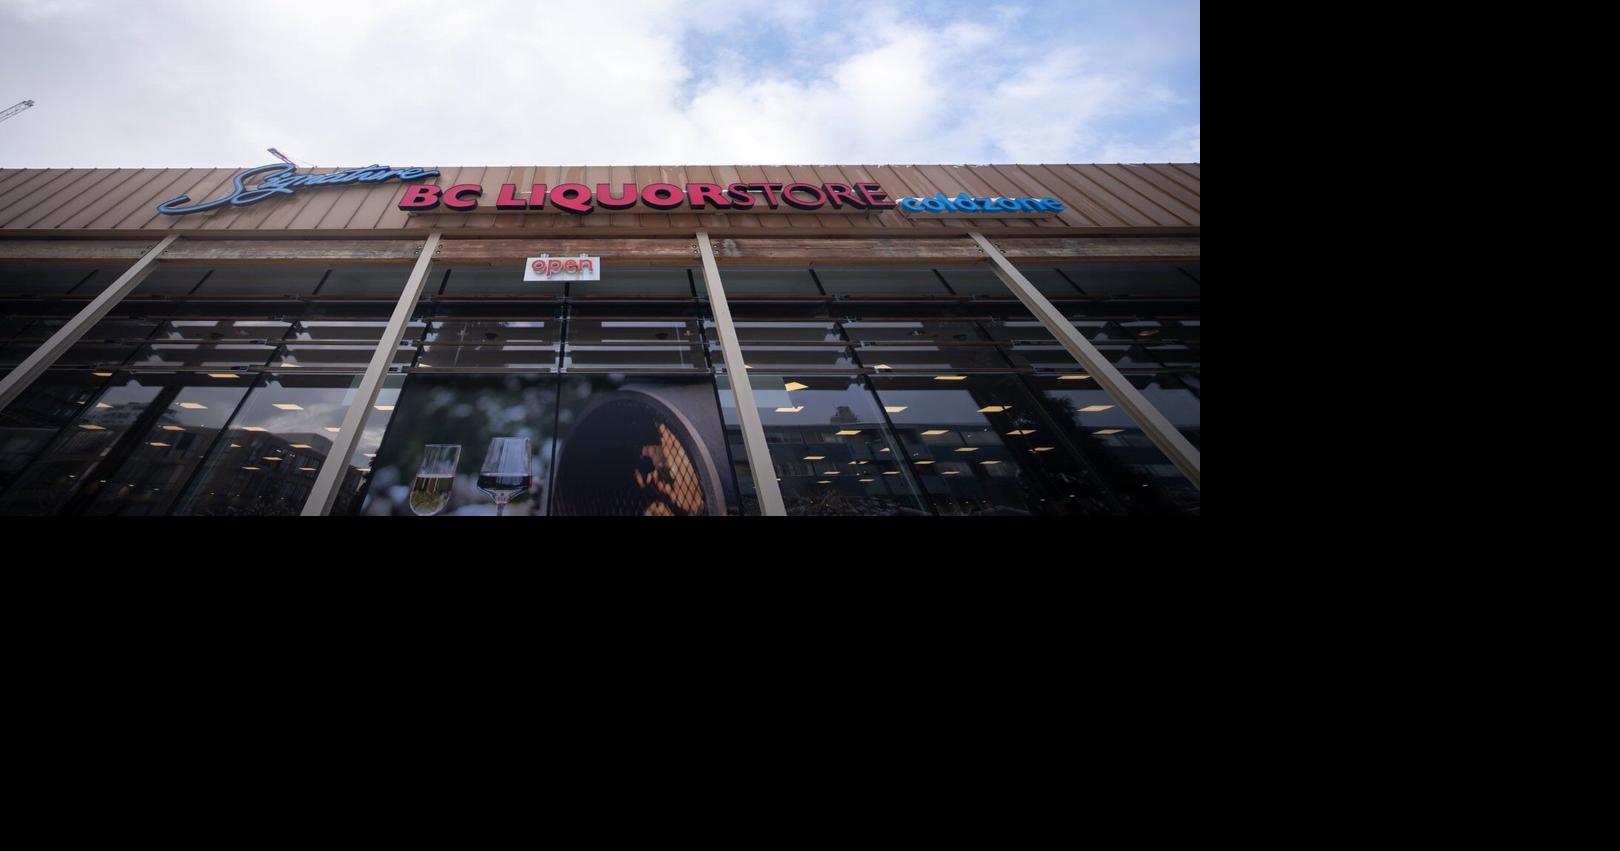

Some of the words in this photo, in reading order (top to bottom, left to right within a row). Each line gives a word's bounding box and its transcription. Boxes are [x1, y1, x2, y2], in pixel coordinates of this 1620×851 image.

[157, 163, 440, 215] Signature
[398, 183, 483, 211] BC
[900, 193, 1066, 215] coldzone
[532, 259, 593, 278] open
